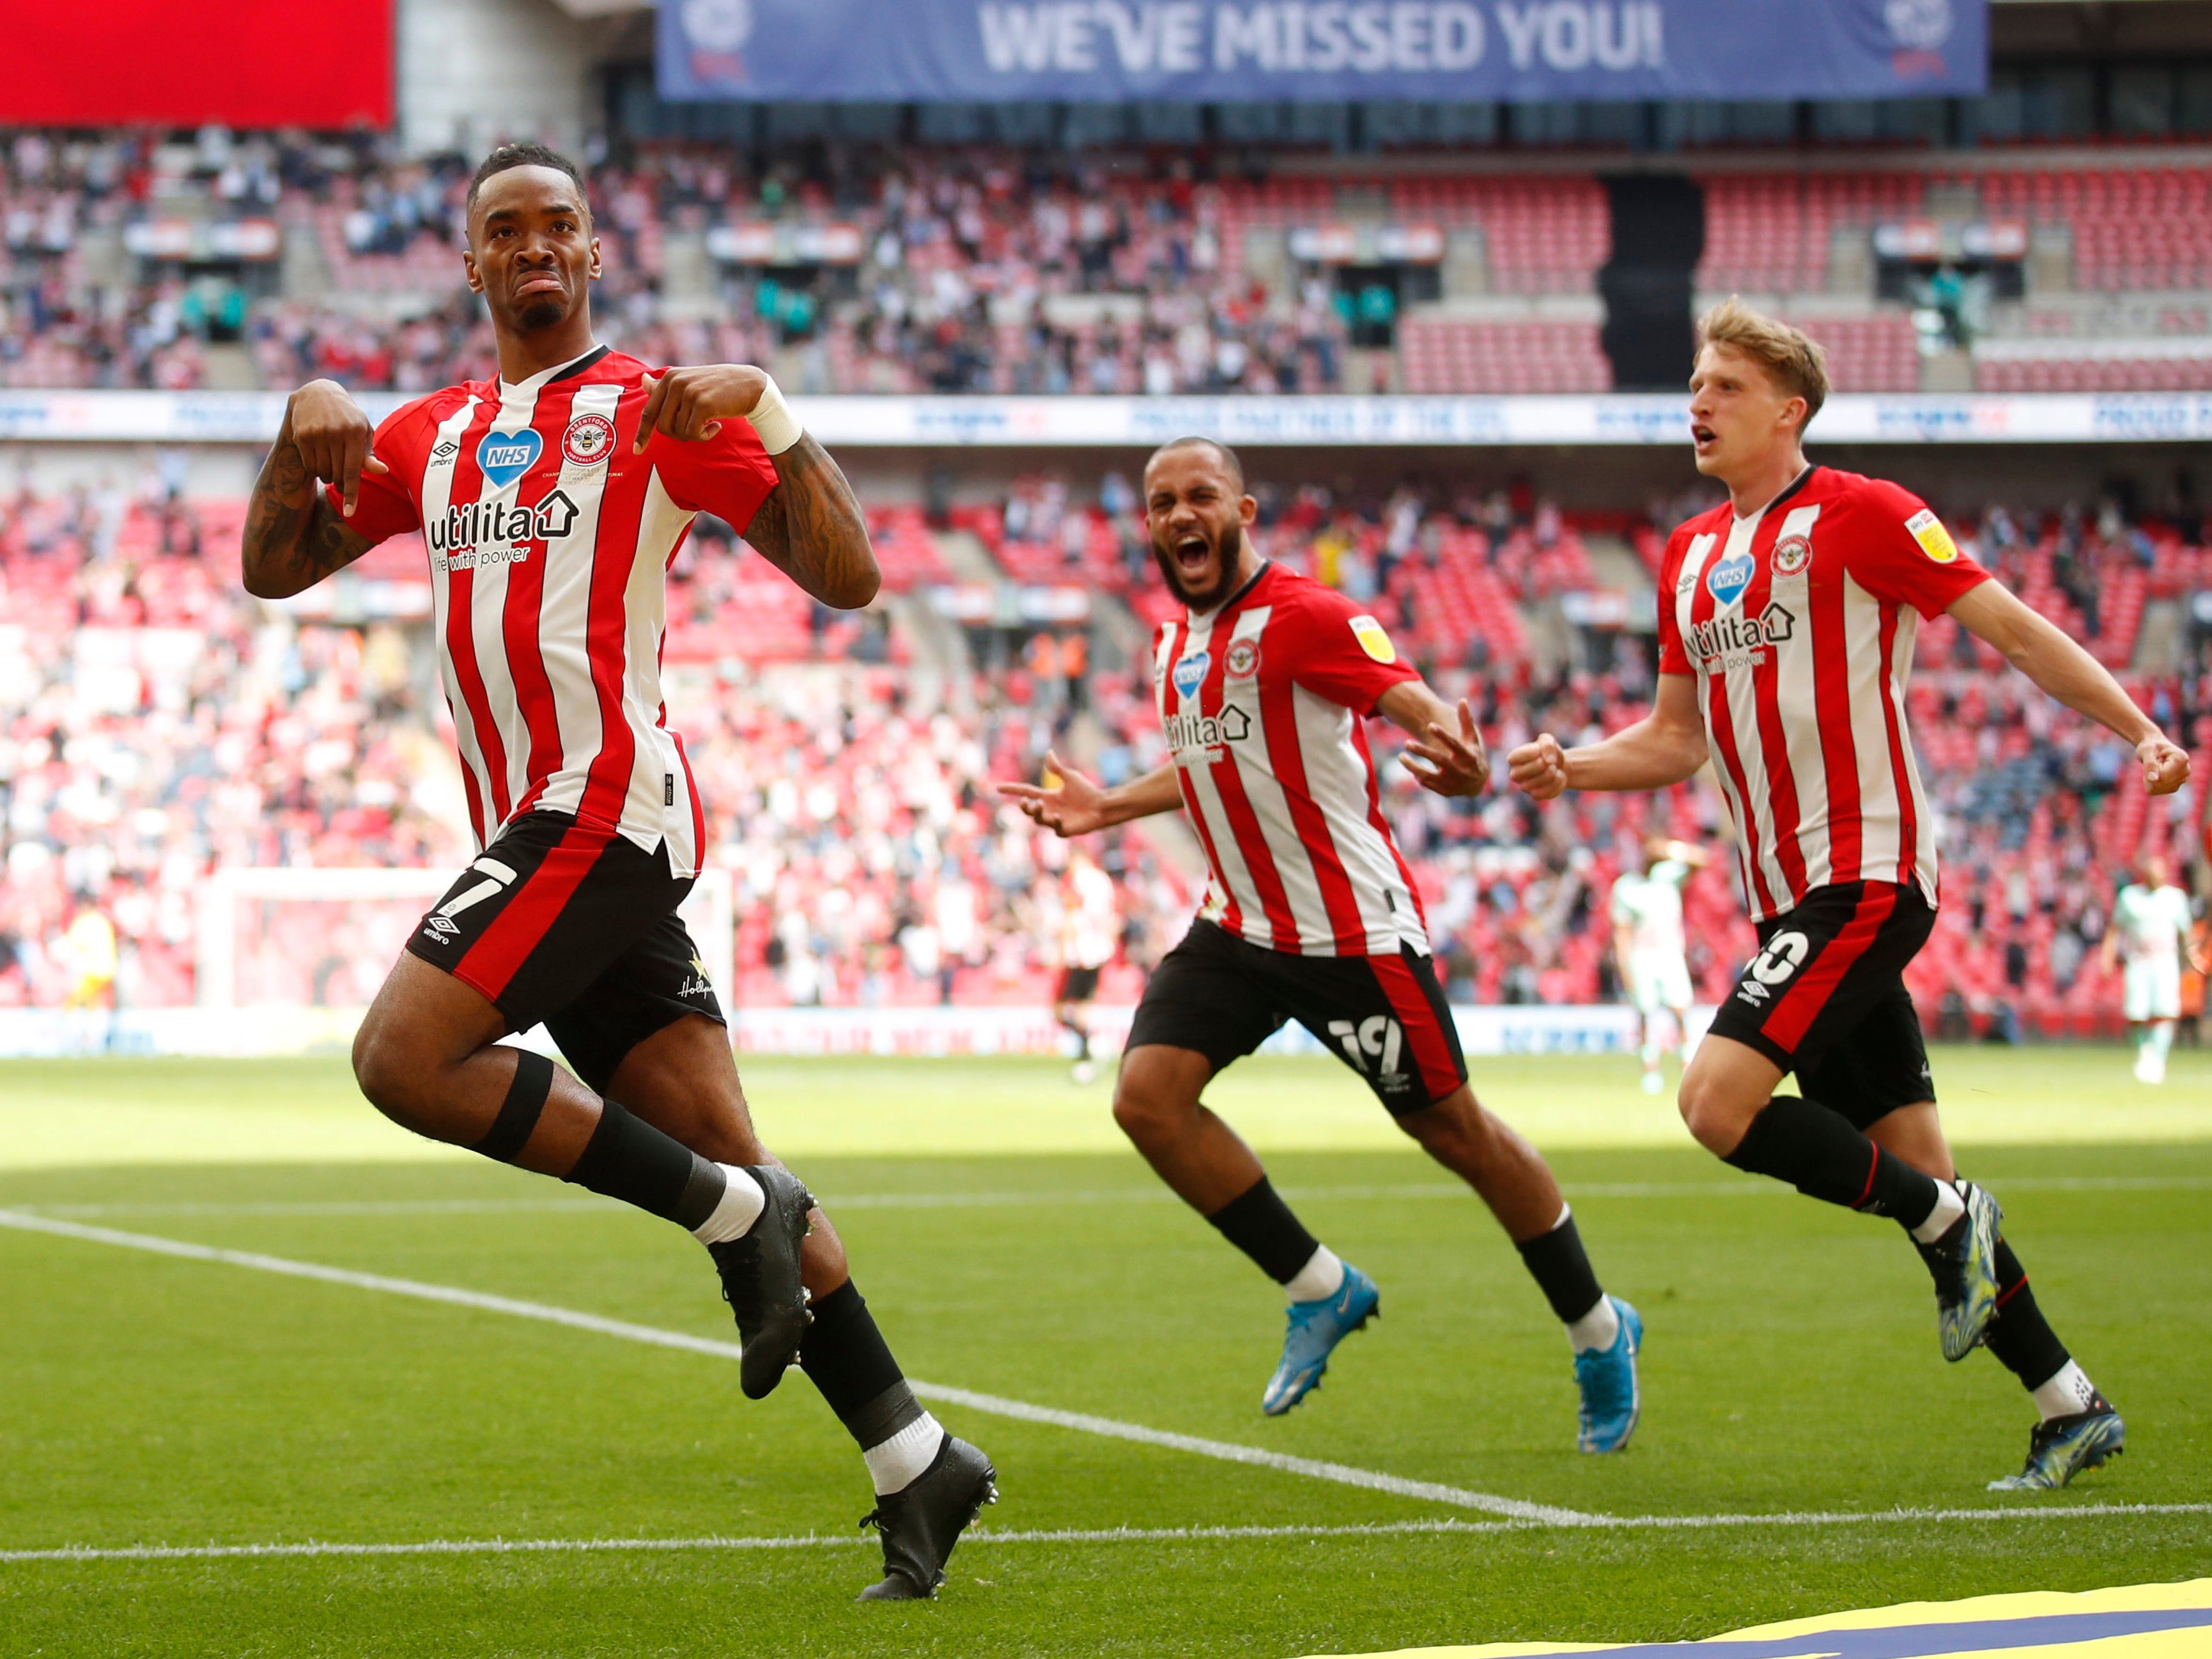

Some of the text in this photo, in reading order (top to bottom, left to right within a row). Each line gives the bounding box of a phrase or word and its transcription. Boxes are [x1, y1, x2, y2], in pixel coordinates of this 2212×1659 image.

[978, 0, 1663, 73] WE'VE MISSED YOU!
[570, 418, 608, 432] BRENTFORD
[430, 457, 452, 467] umbro
[488, 447, 526, 465] NHS
[567, 449, 607, 462] FOOTBALL CLUB
[431, 502, 531, 550] utilita
[449, 551, 476, 570] with
[481, 548, 529, 569] power
[1715, 571, 1742, 586] NHS
[437, 857, 518, 918] 7
[423, 927, 449, 945] umbro
[1736, 991, 1761, 1008] umbro
[1327, 1015, 1402, 1074] 19
